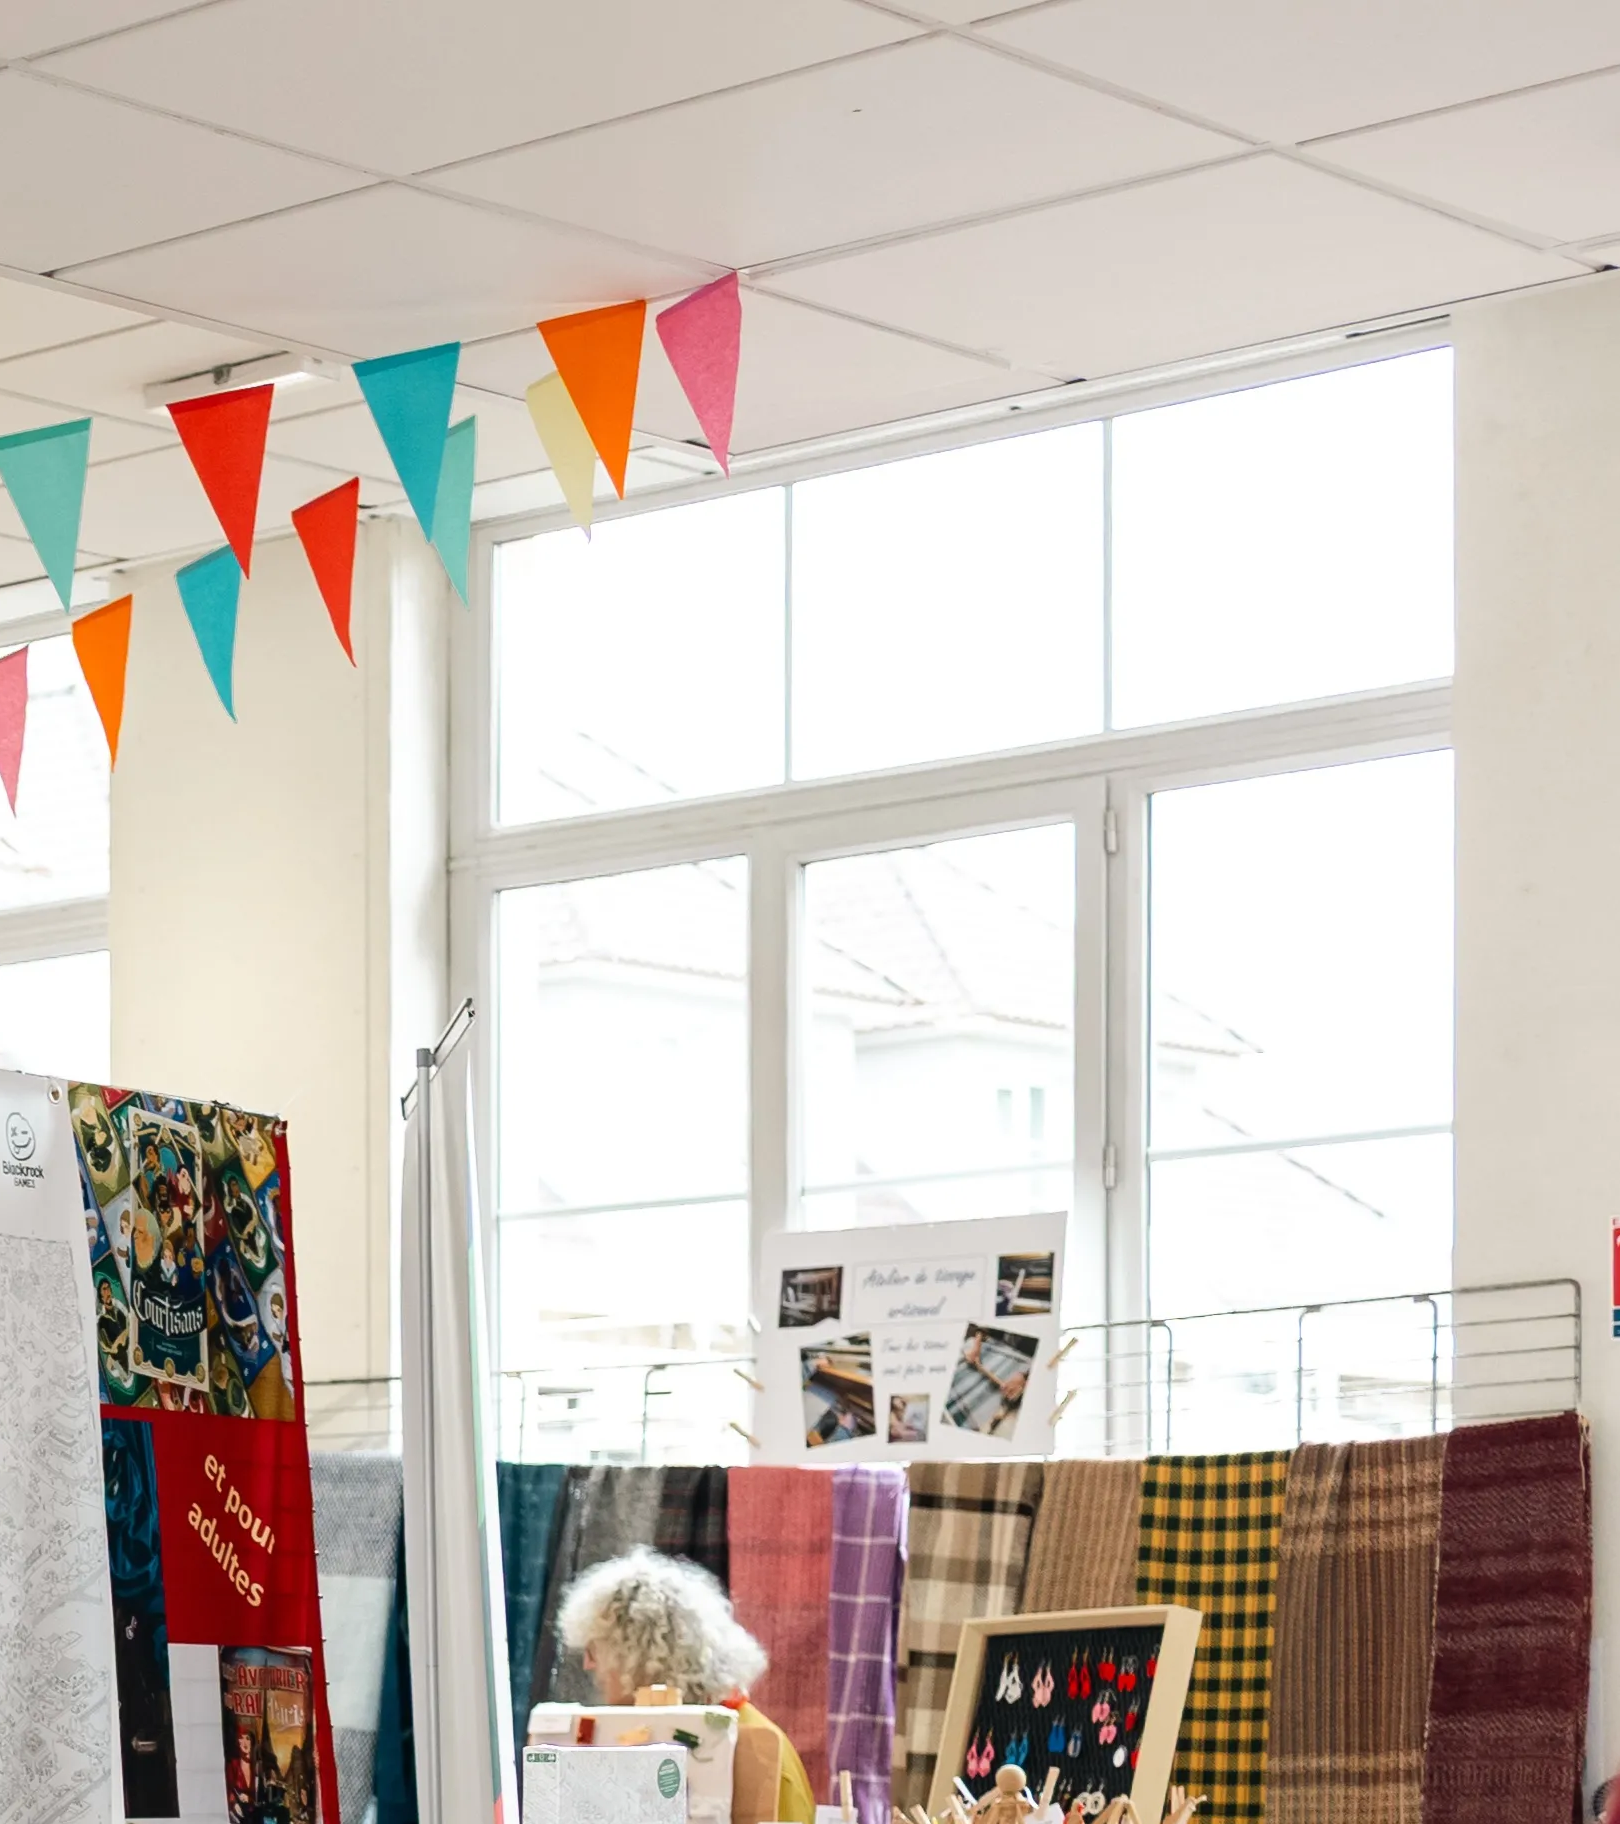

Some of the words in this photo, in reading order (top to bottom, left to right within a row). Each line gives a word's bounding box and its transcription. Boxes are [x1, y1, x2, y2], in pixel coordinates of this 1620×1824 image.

[2, 1160, 44, 1180] Blackrock
[132, 1277, 205, 1338] Courtisans
[204, 1453, 226, 1492] et
[188, 1502, 265, 1608] adultes
